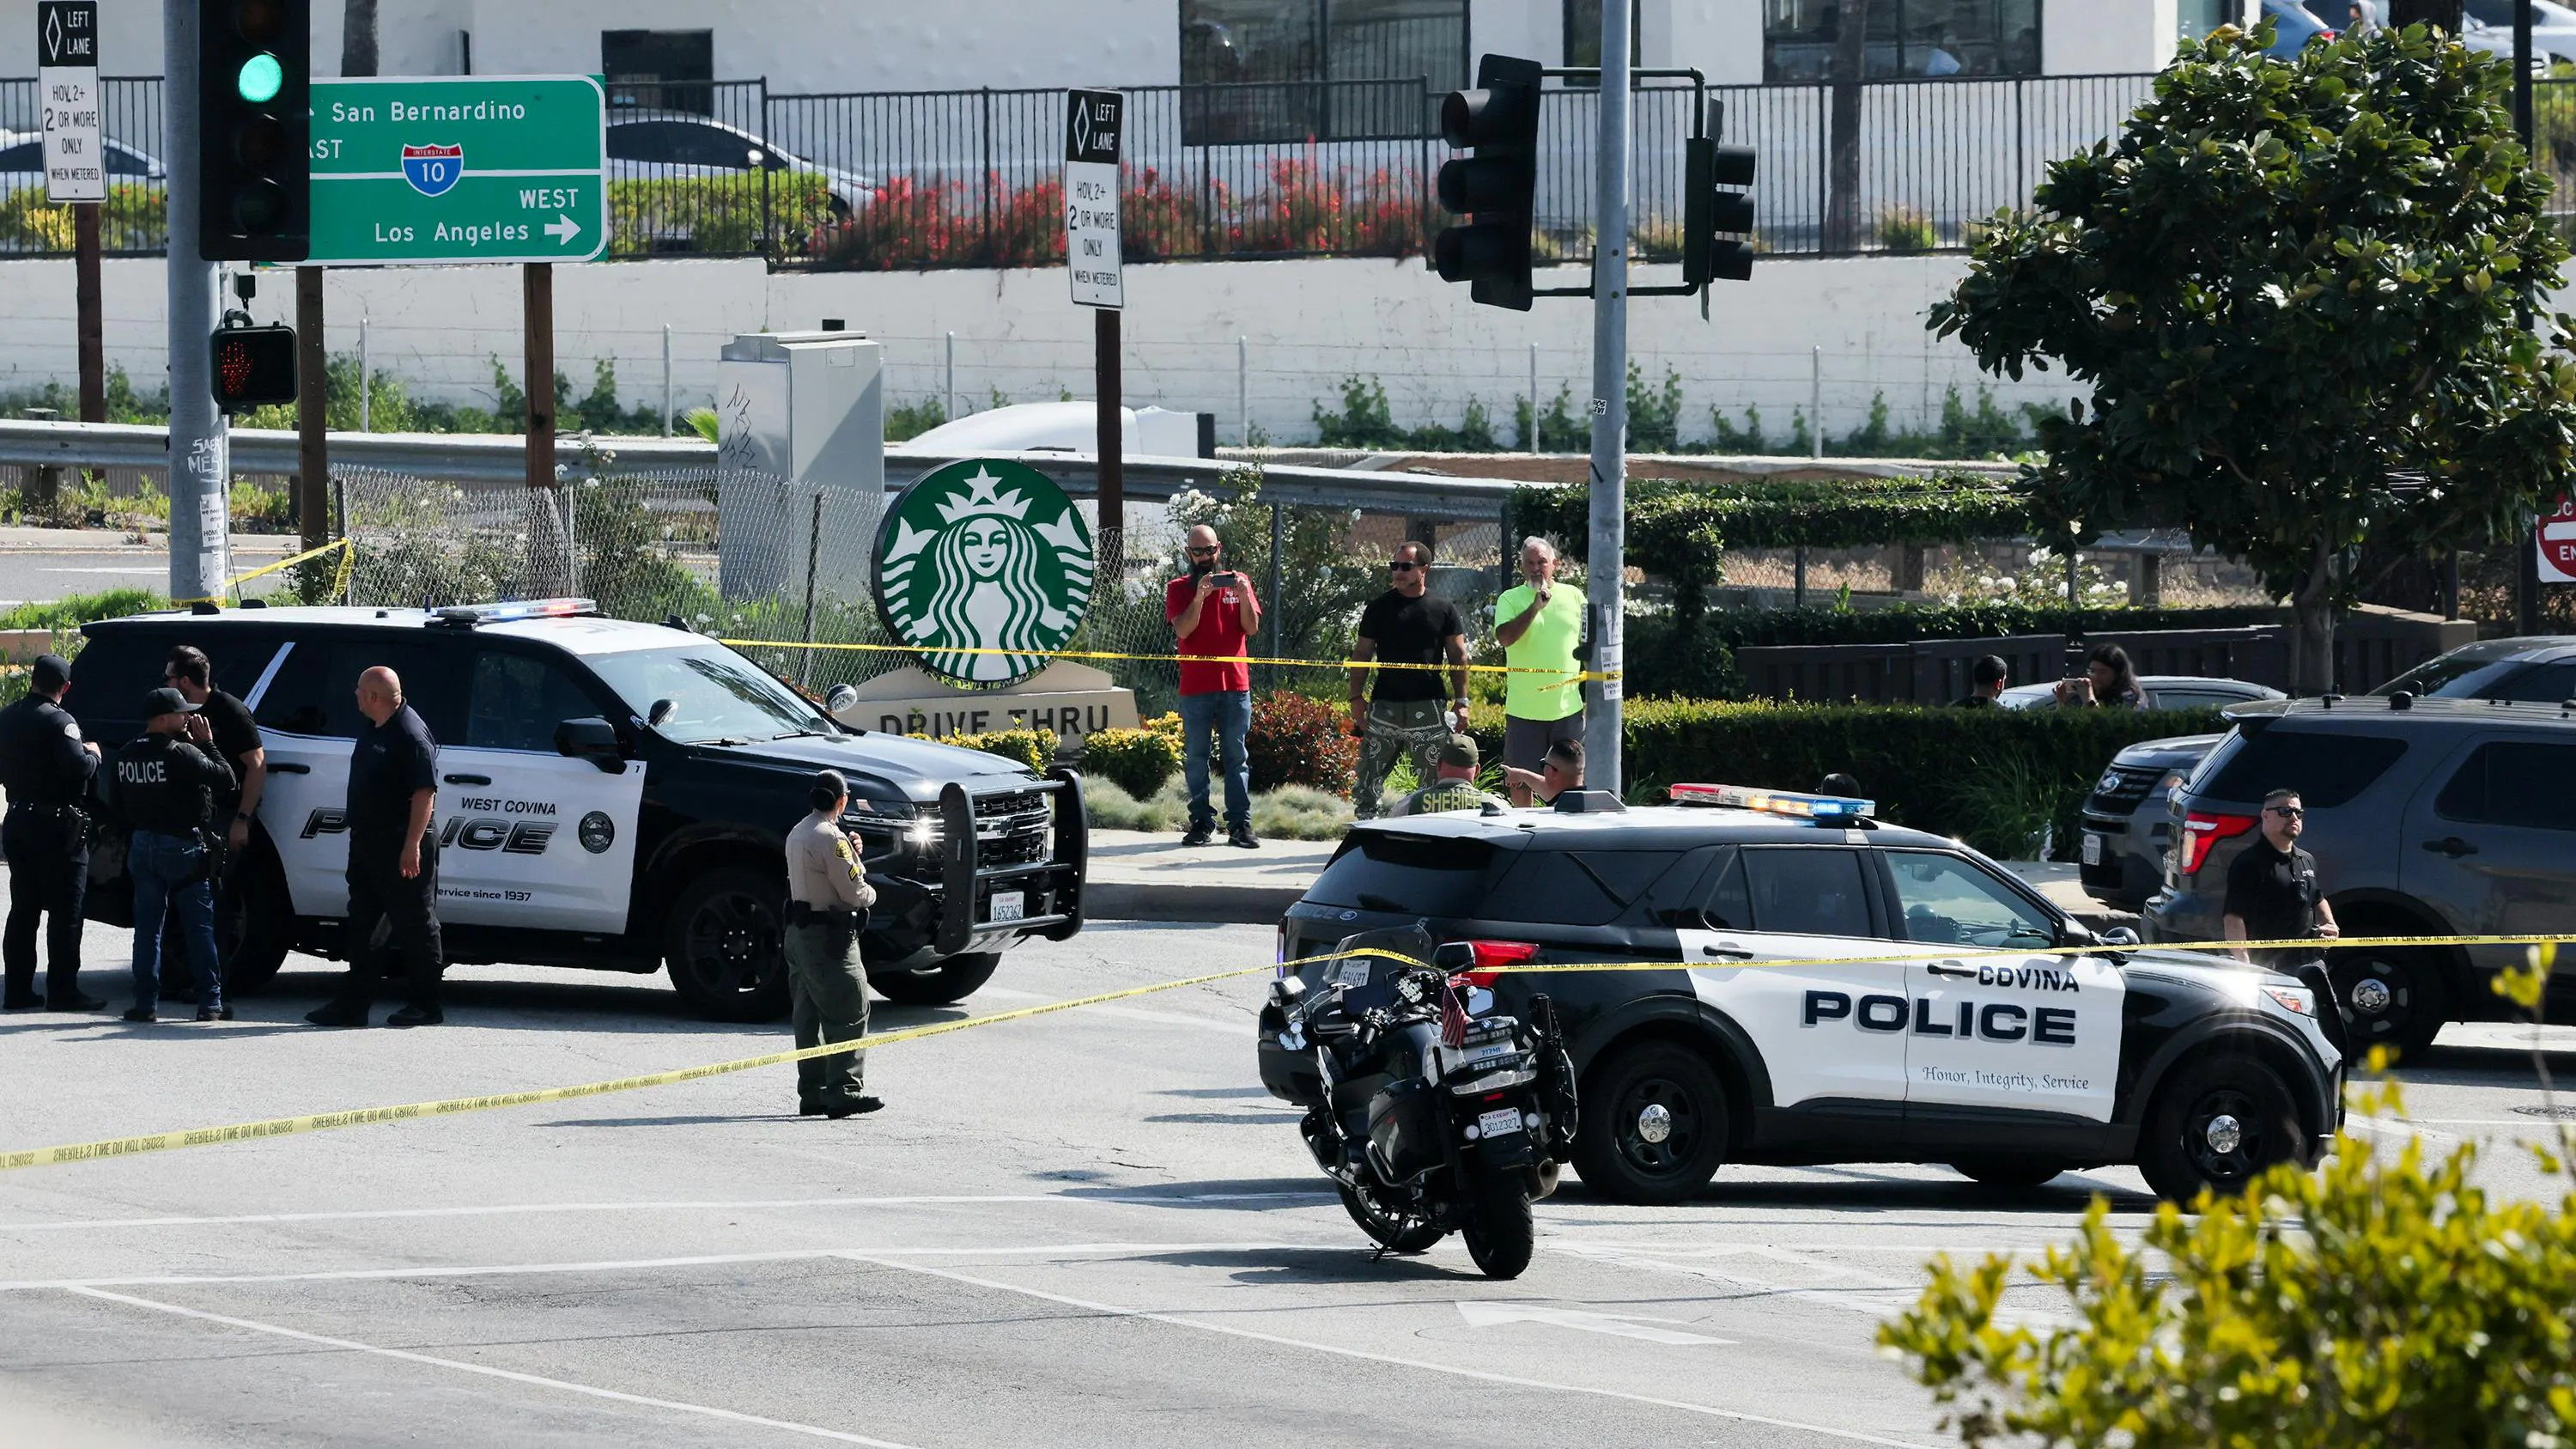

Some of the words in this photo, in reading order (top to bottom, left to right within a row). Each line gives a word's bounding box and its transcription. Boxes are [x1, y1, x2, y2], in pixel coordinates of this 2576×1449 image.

[67, 11, 88, 27] LEFT
[67, 38, 91, 55] LANE
[73, 85, 86, 101] 2+
[44, 107, 54, 131] 2
[58, 111, 70, 128] OR
[73, 110, 97, 127] MORE
[331, 101, 375, 123] San
[391, 100, 526, 122] Bernardino
[1095, 102, 1115, 123] LEFT
[61, 138, 82, 155] ONLY
[1092, 131, 1115, 151] LANE
[413, 148, 452, 156] INTERSTATE
[51, 168, 70, 180] WHEN
[71, 167, 99, 180] METERED
[422, 161, 445, 183] 10
[519, 188, 580, 210] WEST
[1094, 182, 1107, 200] 2+
[1069, 204, 1078, 231] 2
[1080, 210, 1092, 226] OR
[1093, 211, 1115, 230] MORE
[374, 222, 414, 243] Los
[434, 221, 530, 247] Angeles
[1083, 238, 1103, 258] ONLY
[1074, 270, 1091, 285] WHEN
[1092, 271, 1118, 287] METERED
[880, 709, 989, 740] DRIVE
[1008, 704, 1109, 736] THRU
[118, 760, 167, 784] POLICE
[461, 796, 501, 812] WEST
[507, 799, 557, 816] COVINA
[300, 806, 560, 855] PICE
[437, 887, 471, 898] ervice
[472, 889, 501, 899] since
[504, 890, 532, 902] 1937
[1978, 965, 2080, 992] COVINA
[1800, 989, 2077, 1048] POLICE
[1923, 1066, 1970, 1085] Honor,
[1976, 1070, 2038, 1092] Integrity,
[2043, 1074, 2089, 1090] Service
[1485, 1117, 1517, 1133] 3012327
